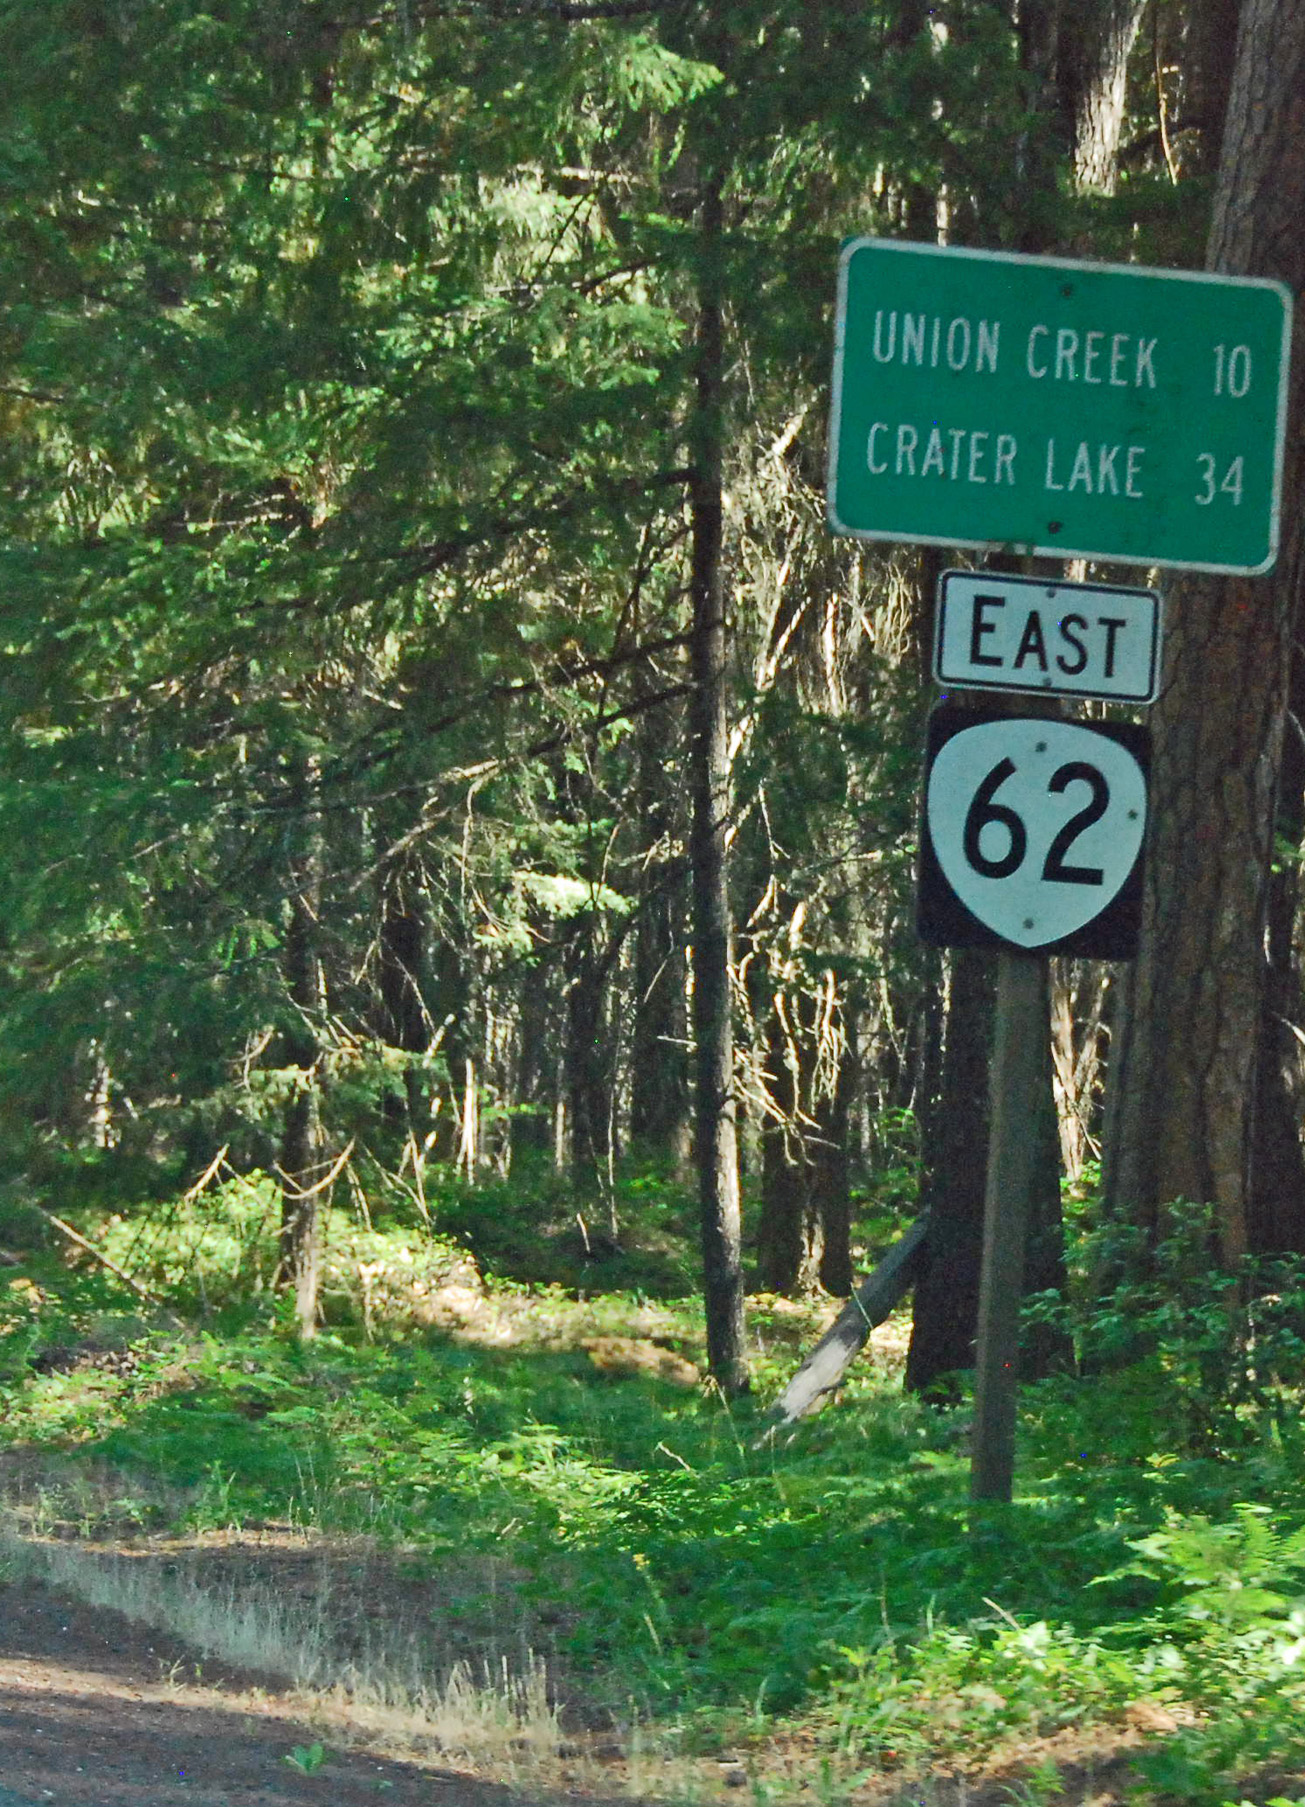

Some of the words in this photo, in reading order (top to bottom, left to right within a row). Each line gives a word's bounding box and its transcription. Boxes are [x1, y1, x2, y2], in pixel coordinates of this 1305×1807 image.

[872, 311, 1001, 373] UNION
[1026, 324, 1158, 389] CREEK
[1213, 344, 1252, 399] 10
[866, 422, 1017, 486] CRATER
[1045, 438, 1146, 499] LAKE
[1195, 452, 1244, 506] 34
[968, 593, 1129, 679] EAST
[961, 756, 1112, 887] 62
